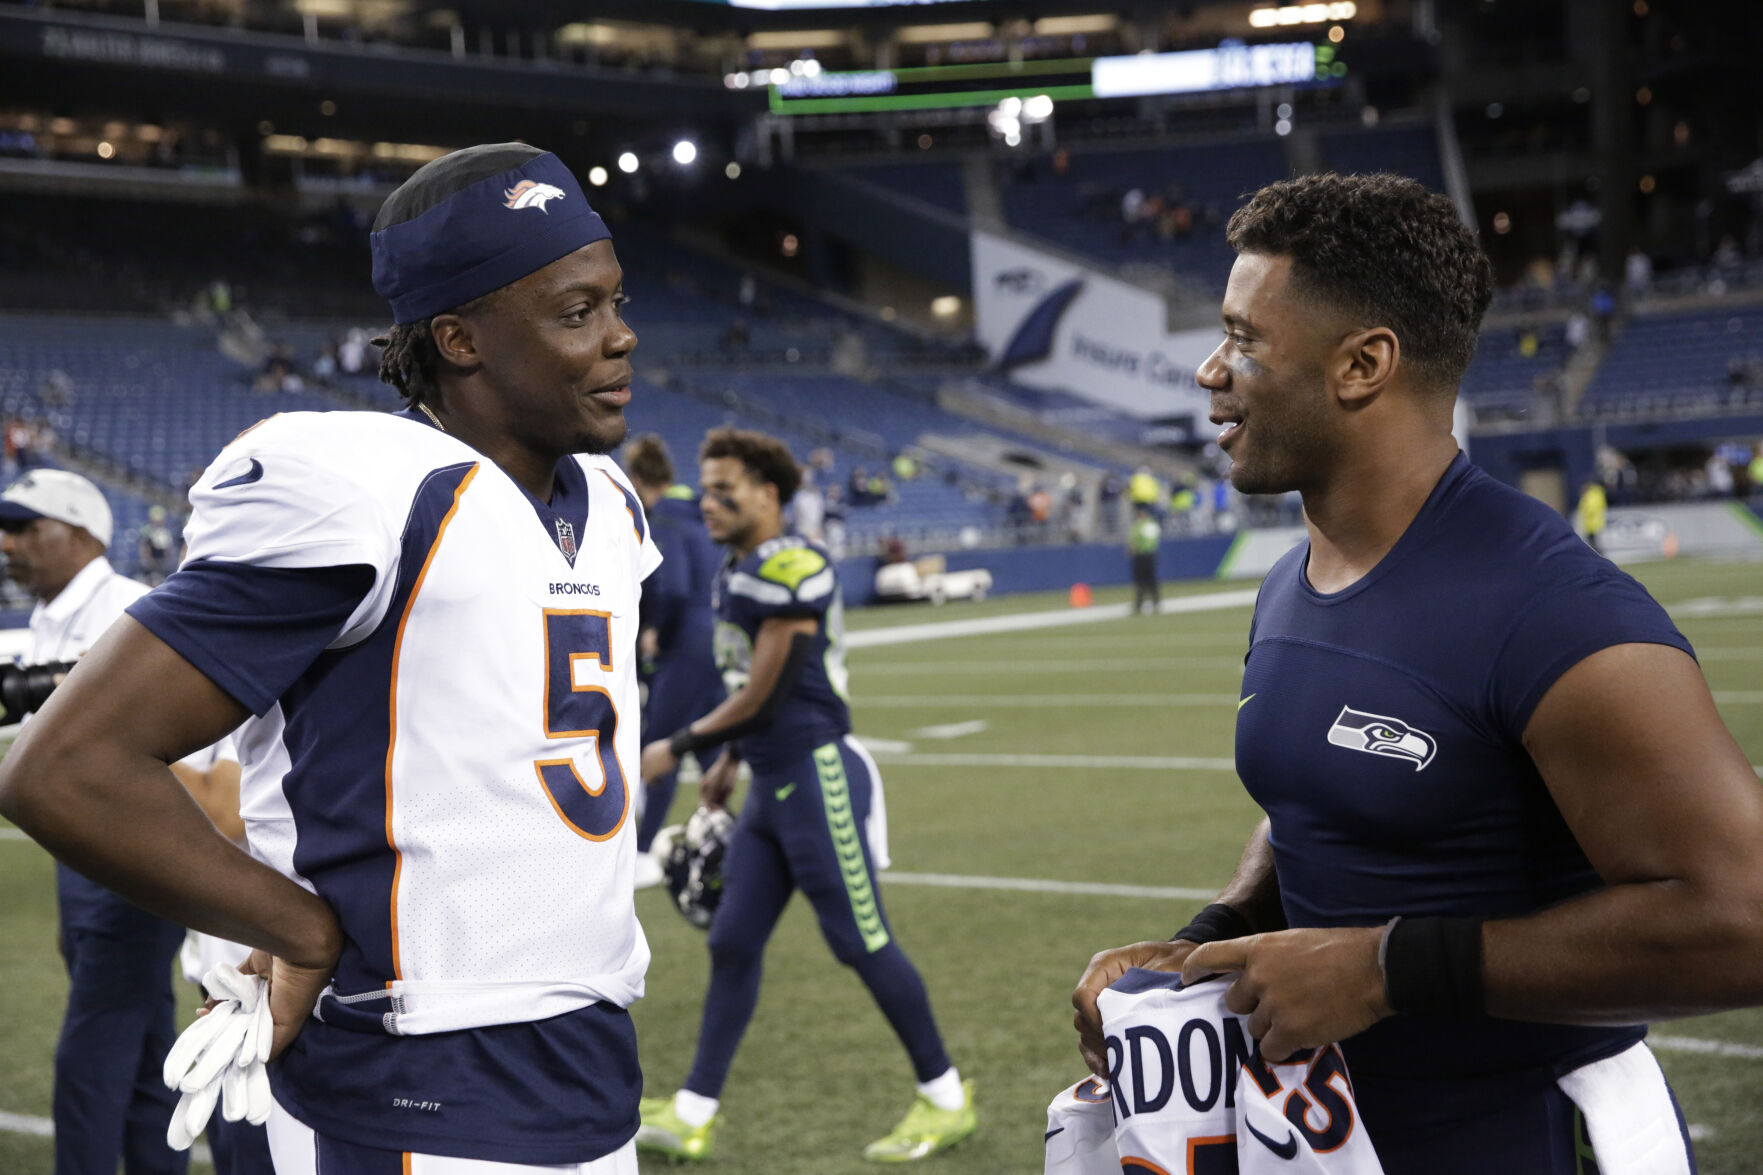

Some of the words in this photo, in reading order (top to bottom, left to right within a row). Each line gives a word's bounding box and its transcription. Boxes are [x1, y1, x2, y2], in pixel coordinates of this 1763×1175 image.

[549, 582, 601, 597] BRONCOS
[534, 607, 630, 843] 5
[392, 1098, 441, 1112] DRI-FIT
